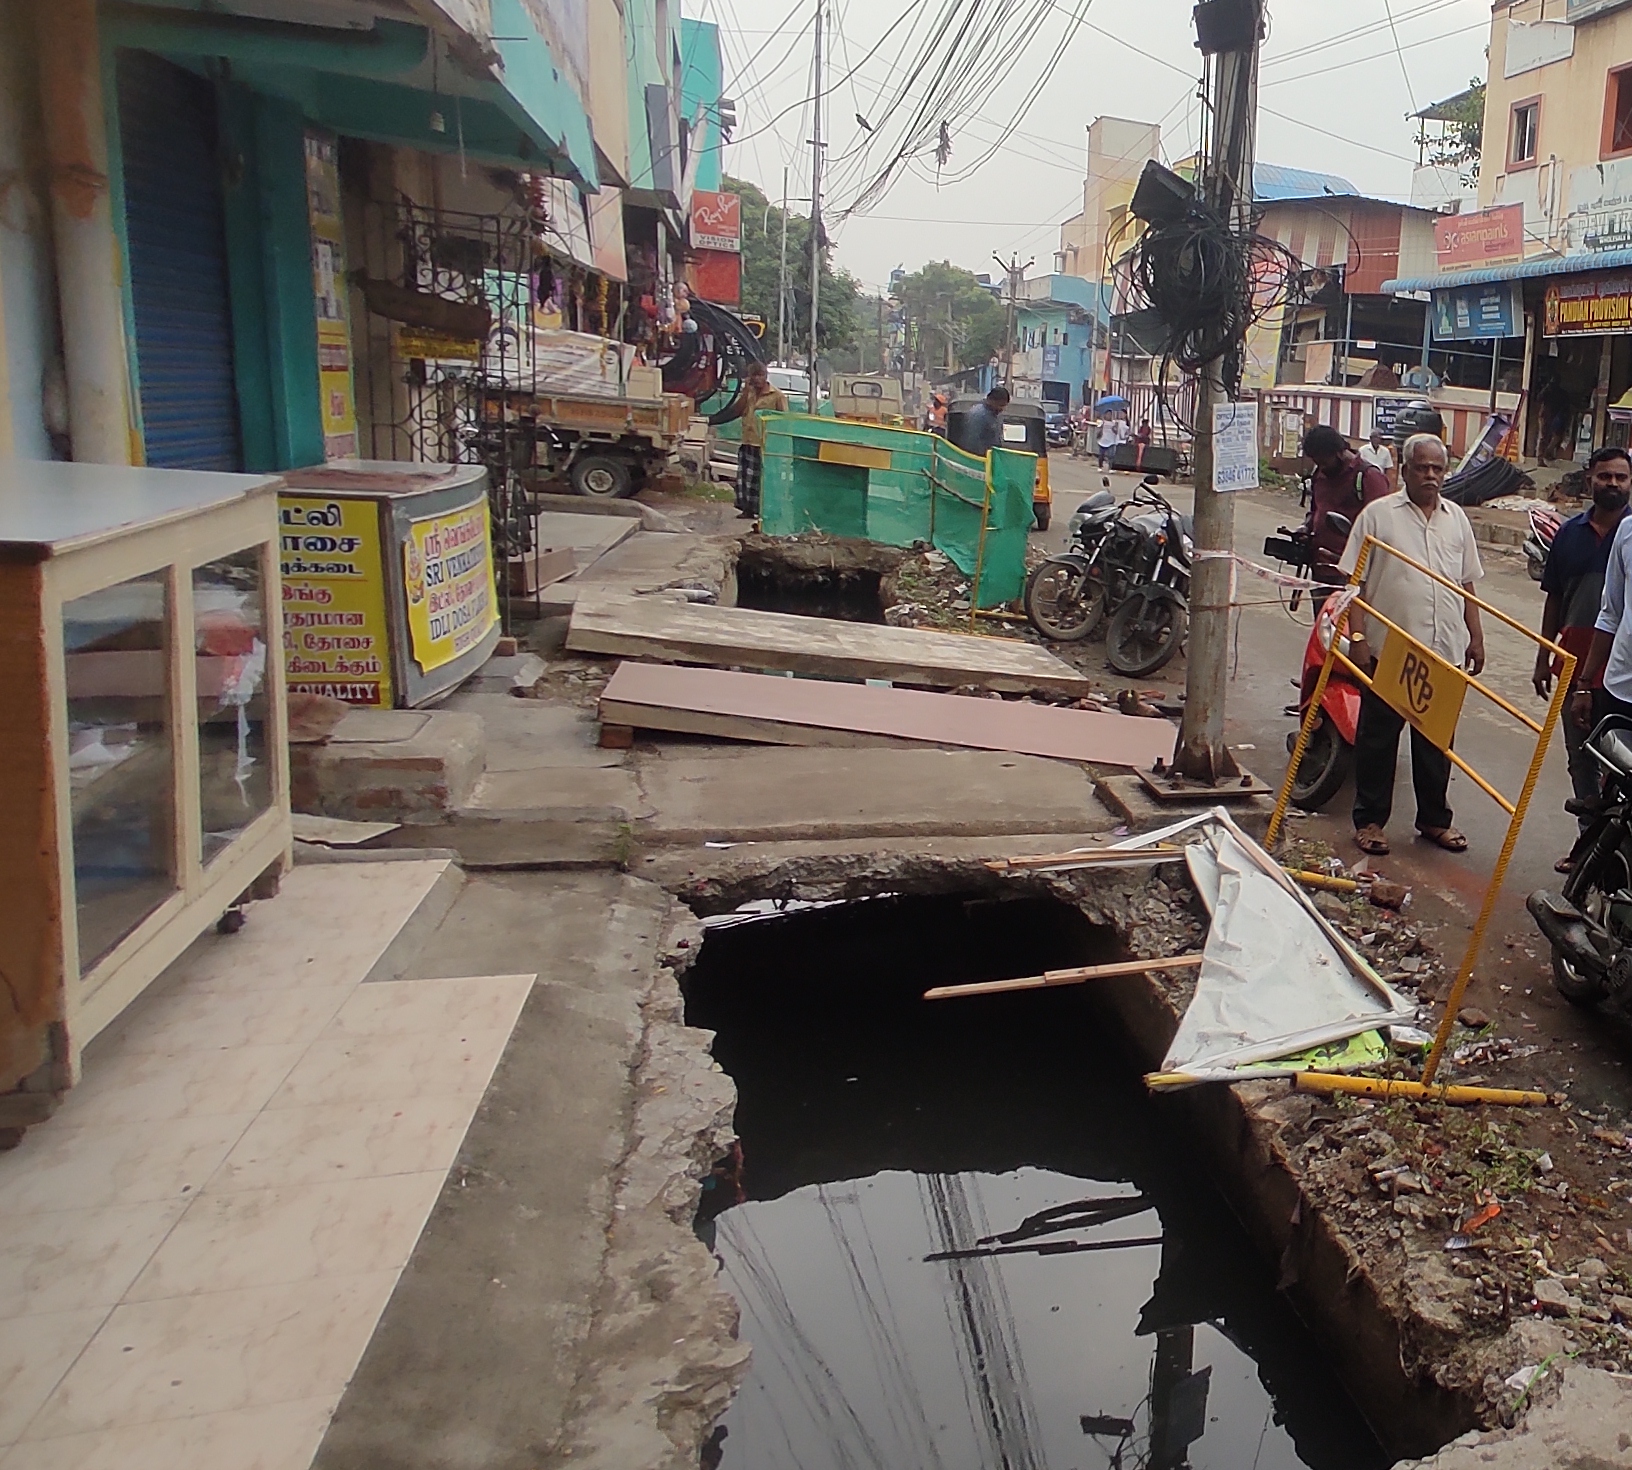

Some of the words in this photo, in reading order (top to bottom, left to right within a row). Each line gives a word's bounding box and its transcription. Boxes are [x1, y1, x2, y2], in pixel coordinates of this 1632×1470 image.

[699, 234, 735, 244] VISION
[699, 240, 736, 248] OPTICS
[1590, 296, 1629, 320] PROVISION
[279, 503, 342, 528] ட்லி
[425, 561, 445, 587] SRI
[429, 613, 451, 641] IDLI
[303, 632, 373, 652] தோசை
[288, 655, 382, 676] கிடைக்கும்
